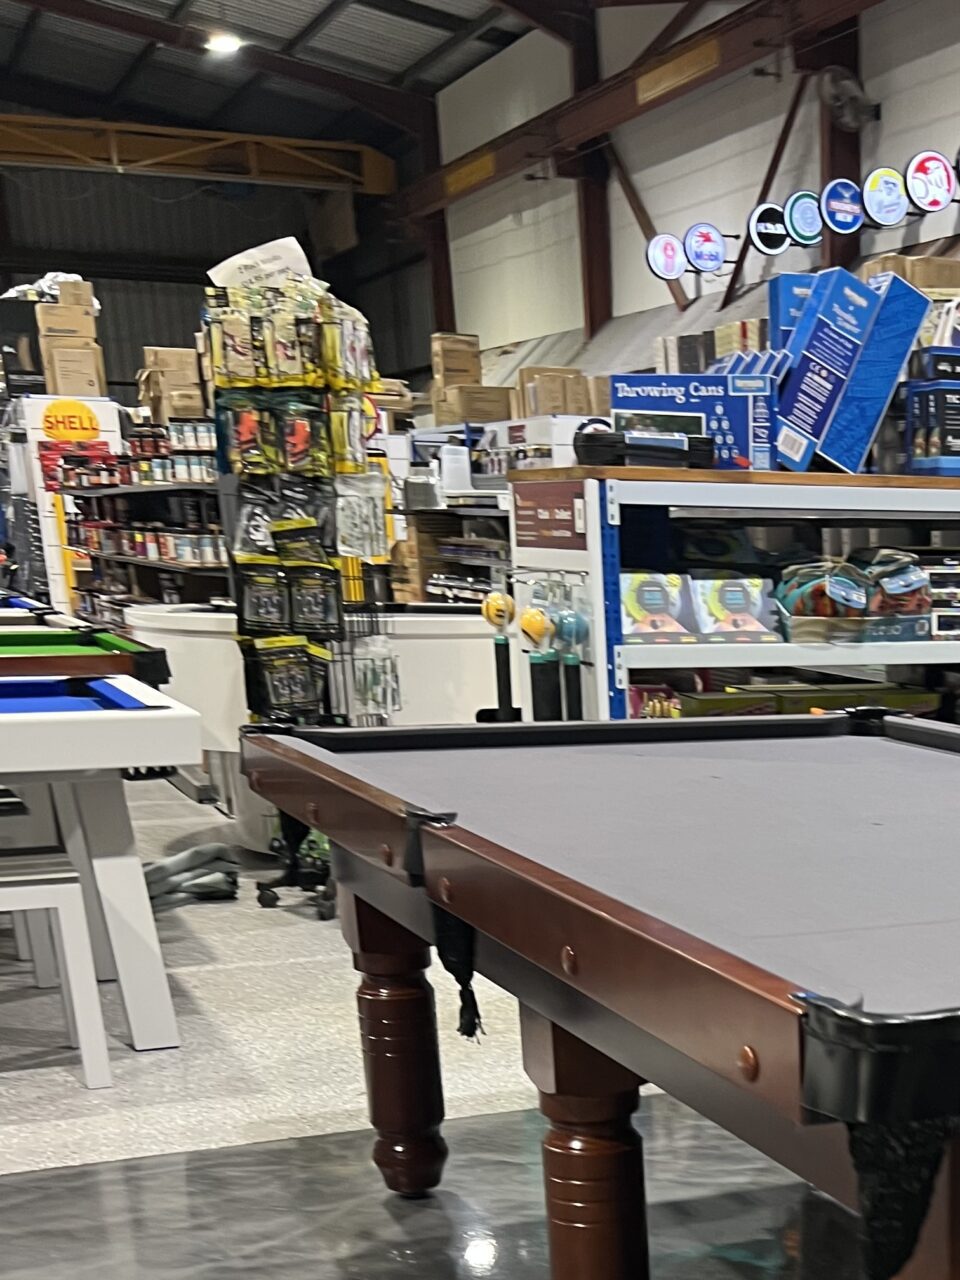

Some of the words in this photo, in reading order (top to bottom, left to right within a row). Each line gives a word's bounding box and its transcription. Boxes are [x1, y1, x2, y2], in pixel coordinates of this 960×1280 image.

[614, 382, 686, 404] Throwing
[689, 382, 725, 396] Cans
[44, 414, 100, 431] SHELL
